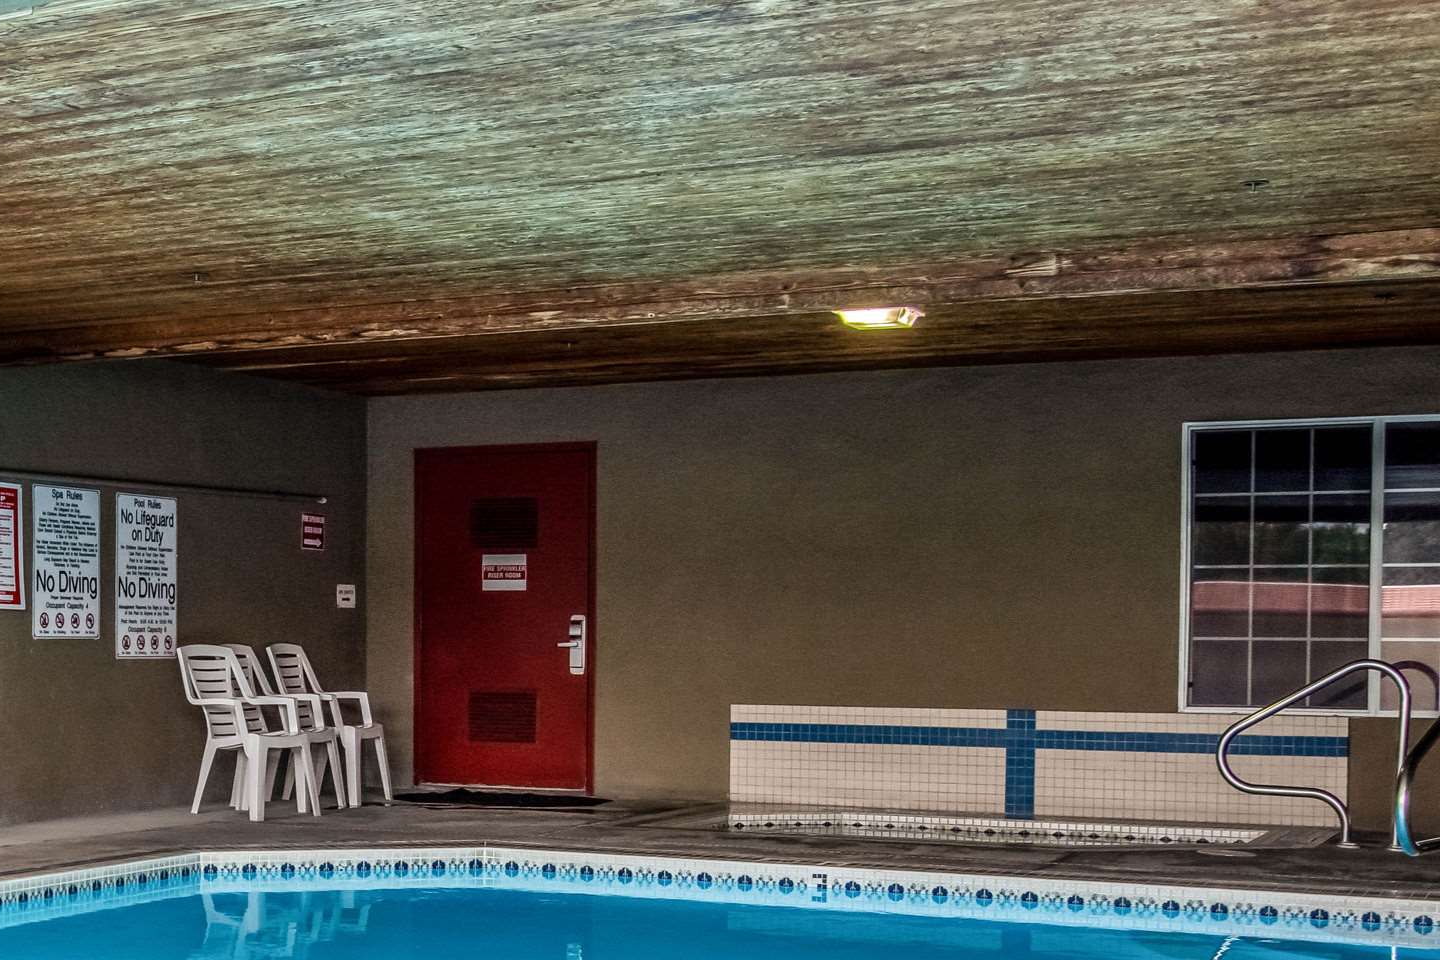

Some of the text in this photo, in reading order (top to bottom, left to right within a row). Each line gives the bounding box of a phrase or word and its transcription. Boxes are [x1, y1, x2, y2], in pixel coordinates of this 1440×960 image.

[51, 489, 83, 500] Spa Rules
[133, 498, 162, 509] Pool Rules
[120, 508, 174, 530] No Lifeguard
[131, 527, 164, 546] on Duty
[36, 569, 98, 600] No Diving
[118, 576, 175, 604] No Diving
